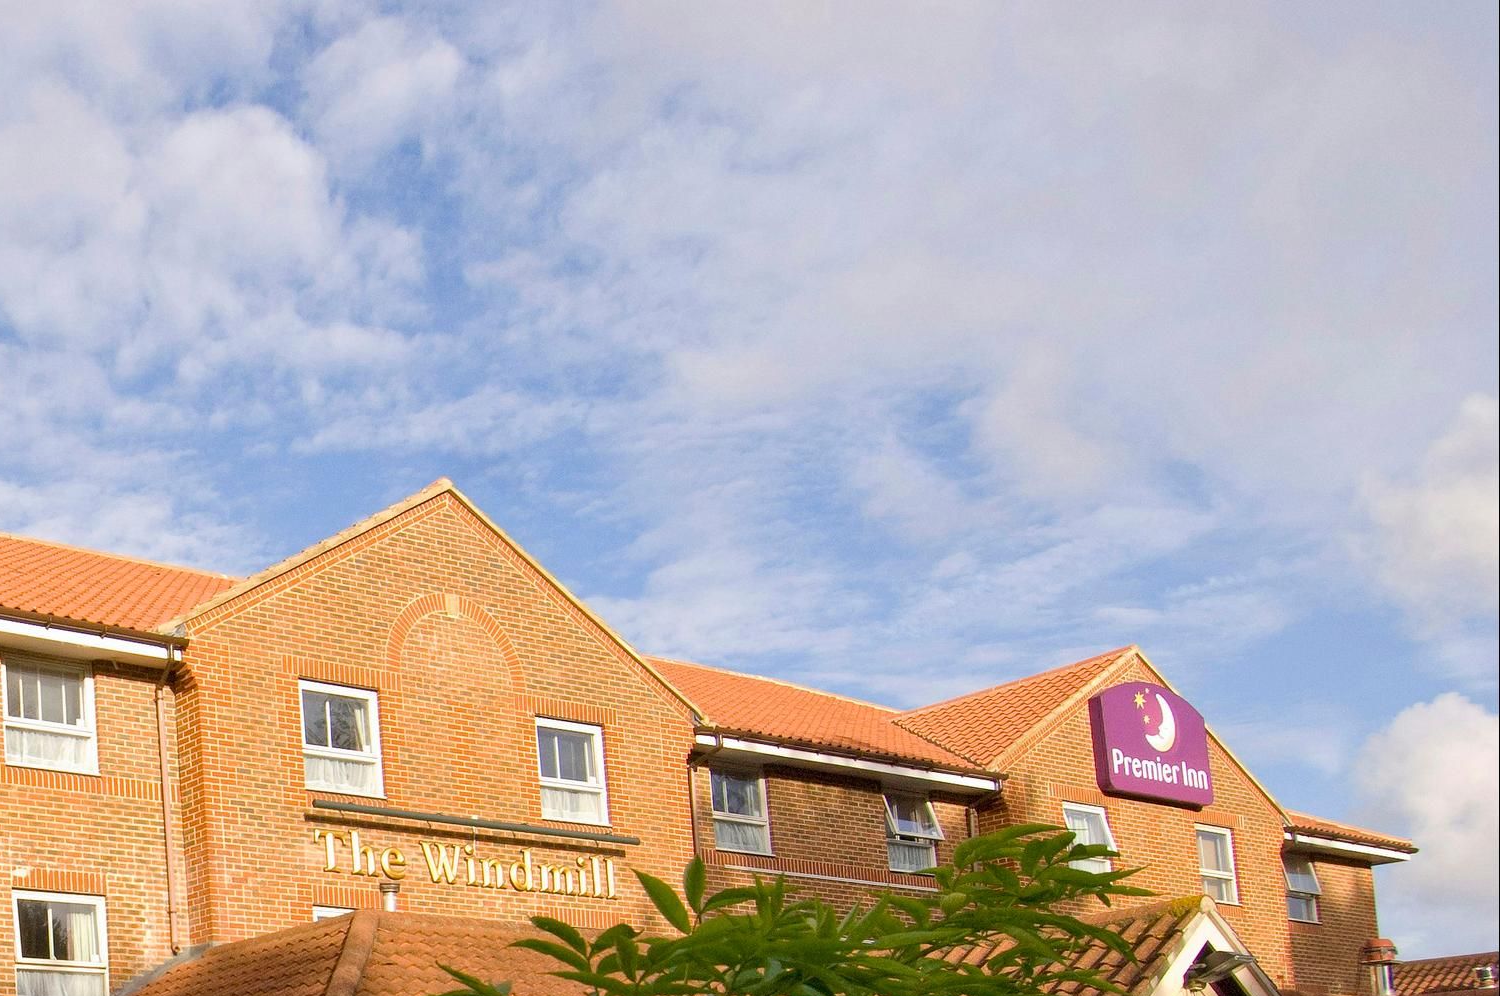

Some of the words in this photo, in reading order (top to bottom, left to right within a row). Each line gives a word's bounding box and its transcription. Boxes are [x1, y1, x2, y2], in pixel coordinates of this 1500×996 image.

[1111, 748, 1180, 784] Premier
[1181, 761, 1209, 790] Inn
[313, 828, 408, 880] The
[418, 839, 618, 900] Windmill
